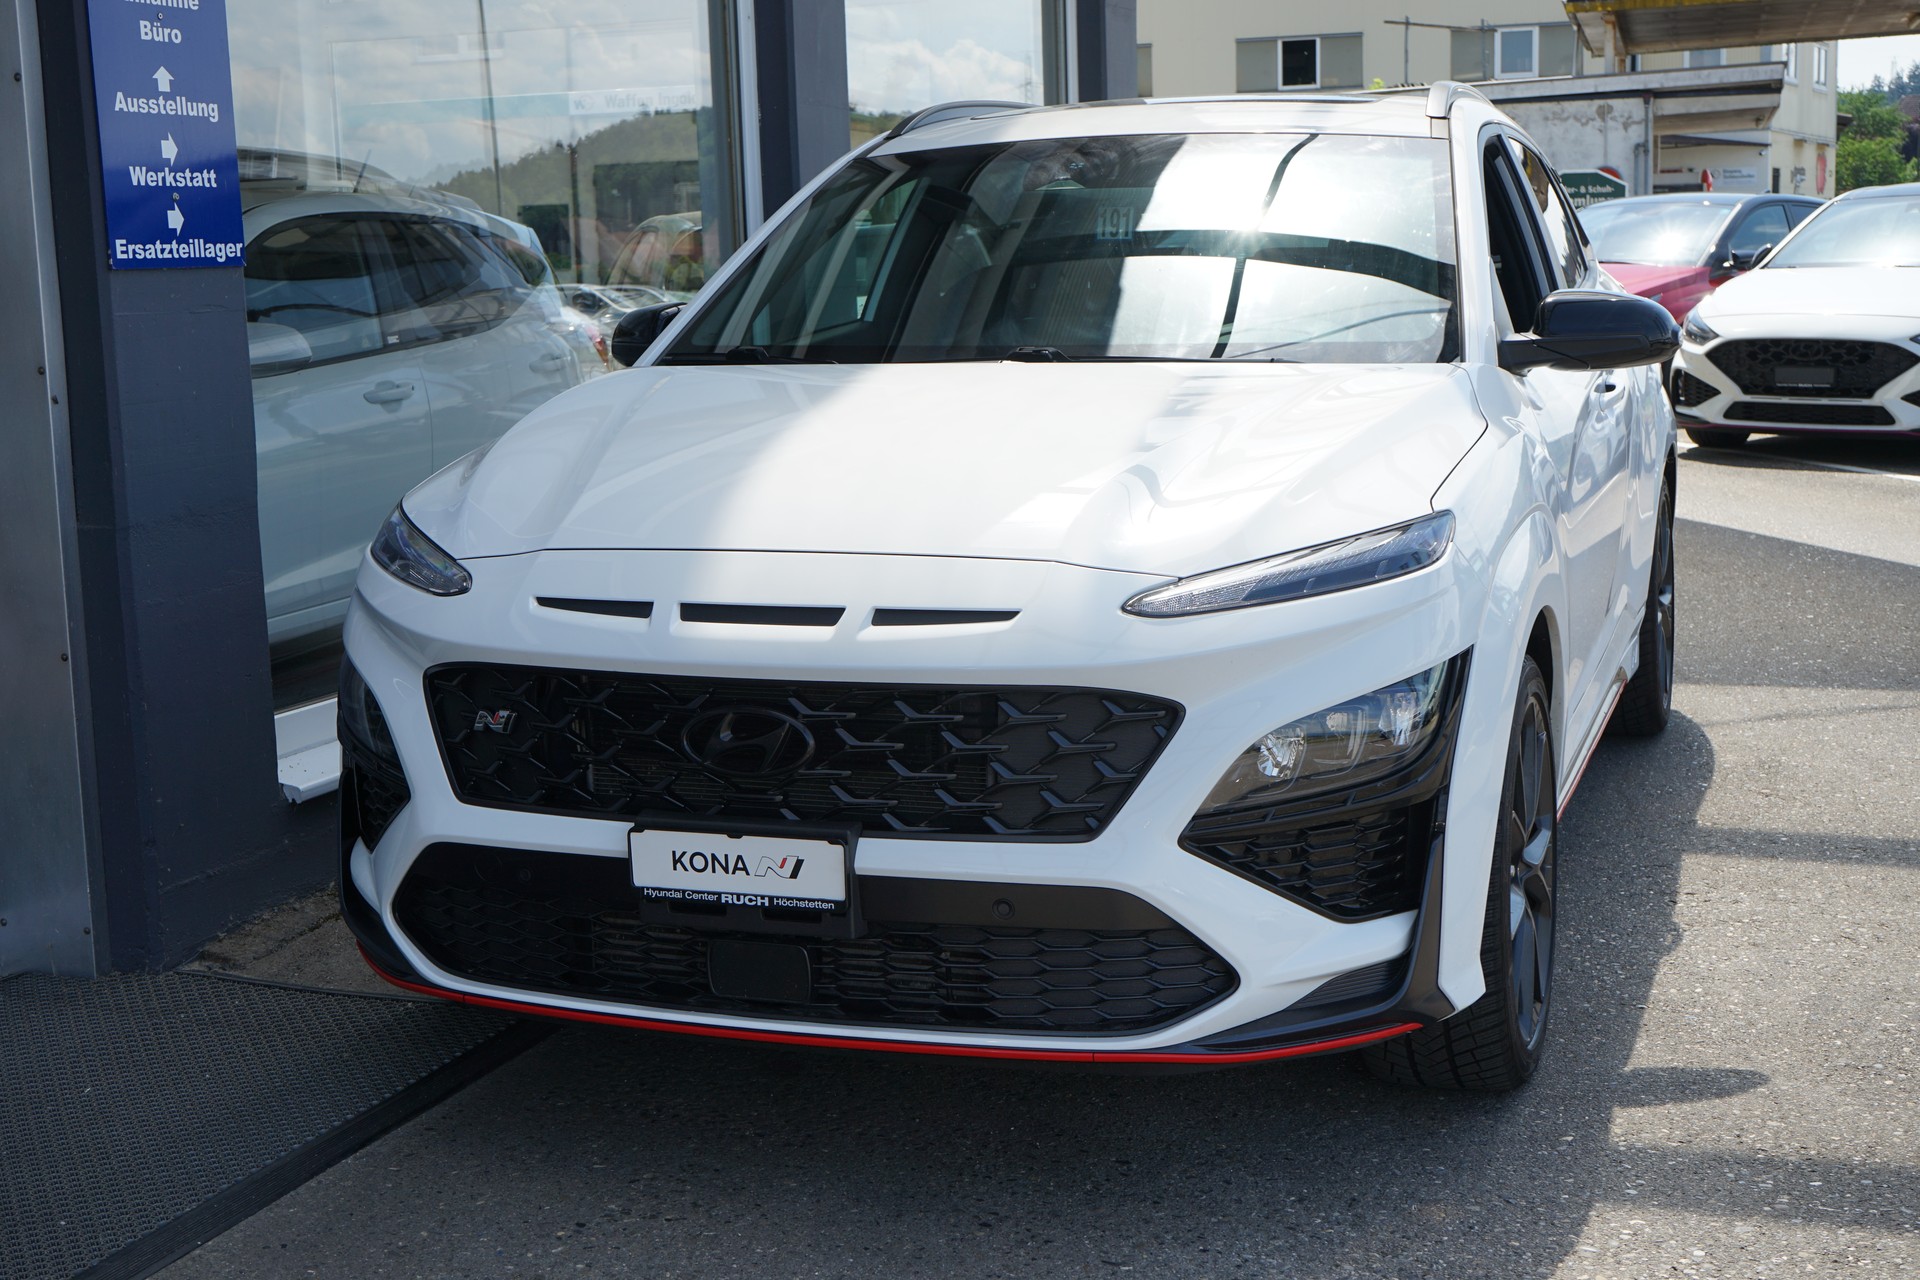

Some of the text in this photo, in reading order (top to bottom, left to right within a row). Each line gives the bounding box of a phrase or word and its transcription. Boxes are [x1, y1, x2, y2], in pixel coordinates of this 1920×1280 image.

[139, 20, 182, 44] Büro
[115, 91, 219, 123] Ausstellung
[129, 165, 217, 188] Werkstatt
[1100, 208, 1131, 238] 191
[115, 238, 243, 263] Ersatzteillager
[671, 850, 751, 877] KONA
[644, 887, 835, 910] Hyundai Center RUCH Höchstetten
